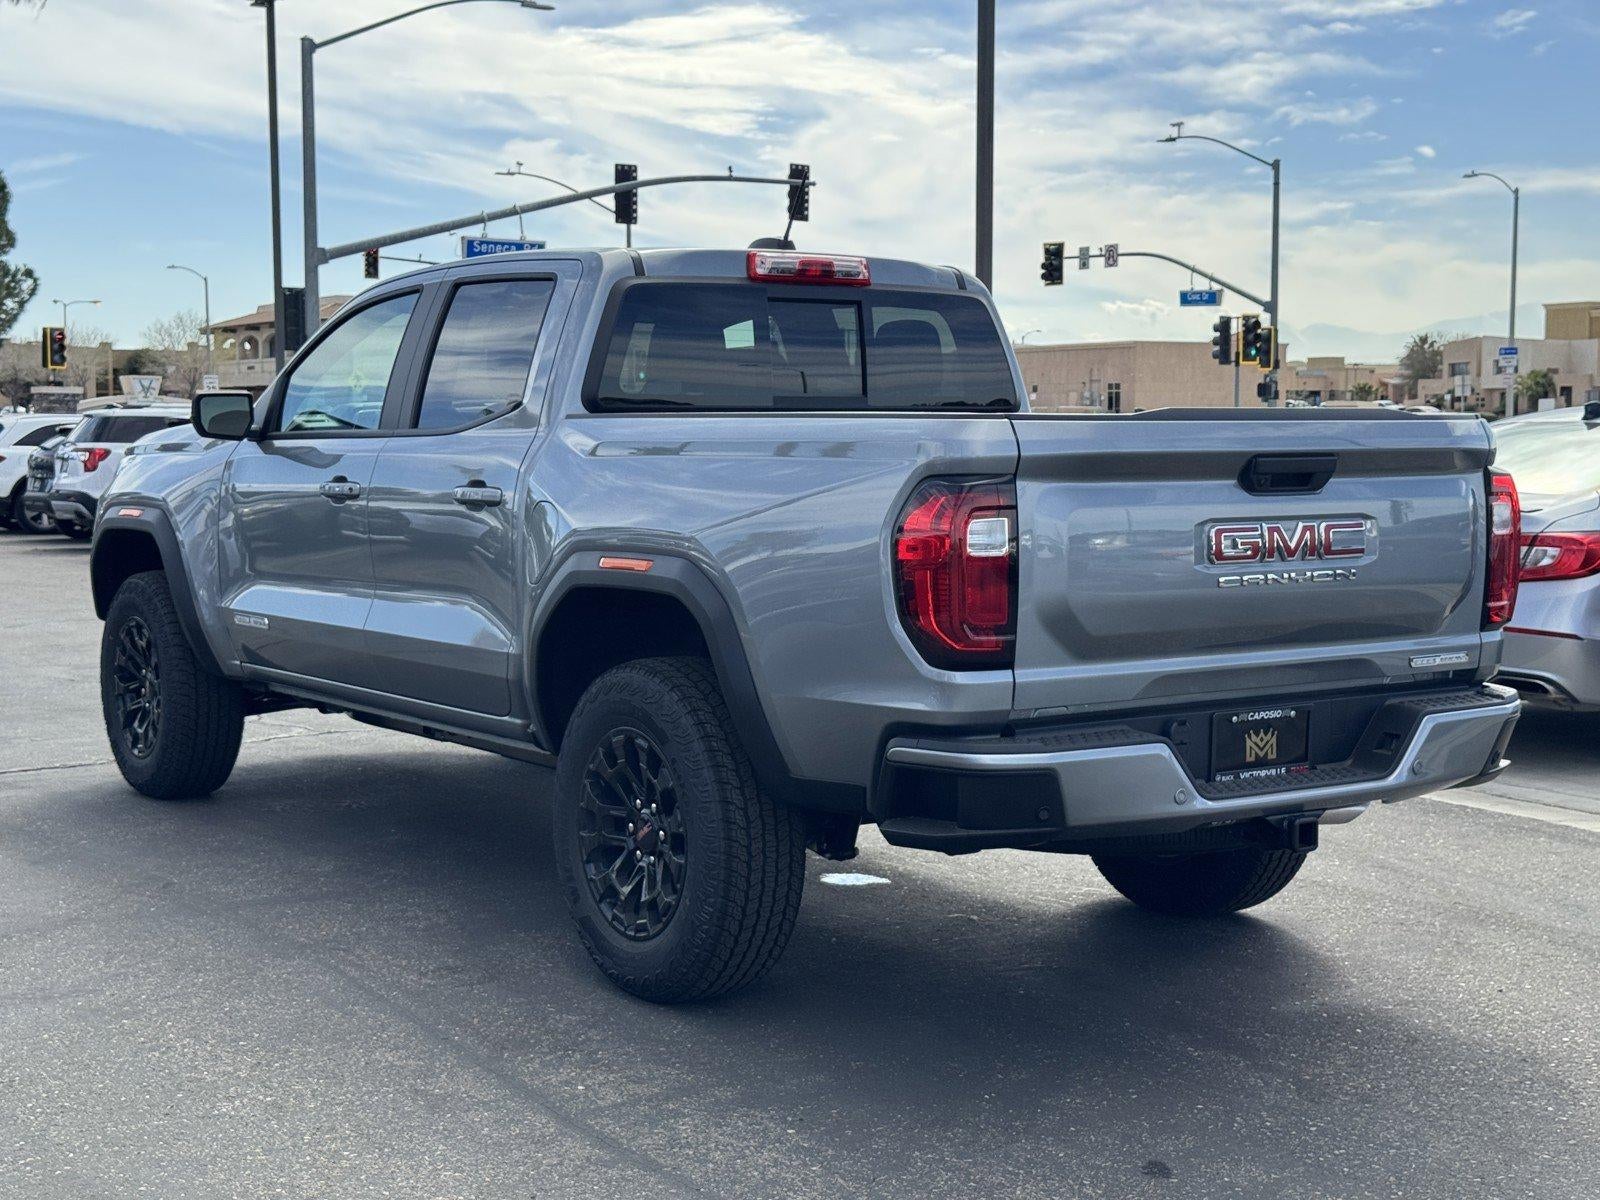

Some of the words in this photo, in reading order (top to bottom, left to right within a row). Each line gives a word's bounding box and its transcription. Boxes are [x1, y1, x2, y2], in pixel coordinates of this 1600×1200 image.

[473, 240, 517, 253] Seneca
[1210, 520, 1366, 564] GMC
[1218, 569, 1357, 588] CANYON
[1247, 709, 1283, 721] CAPOSIO
